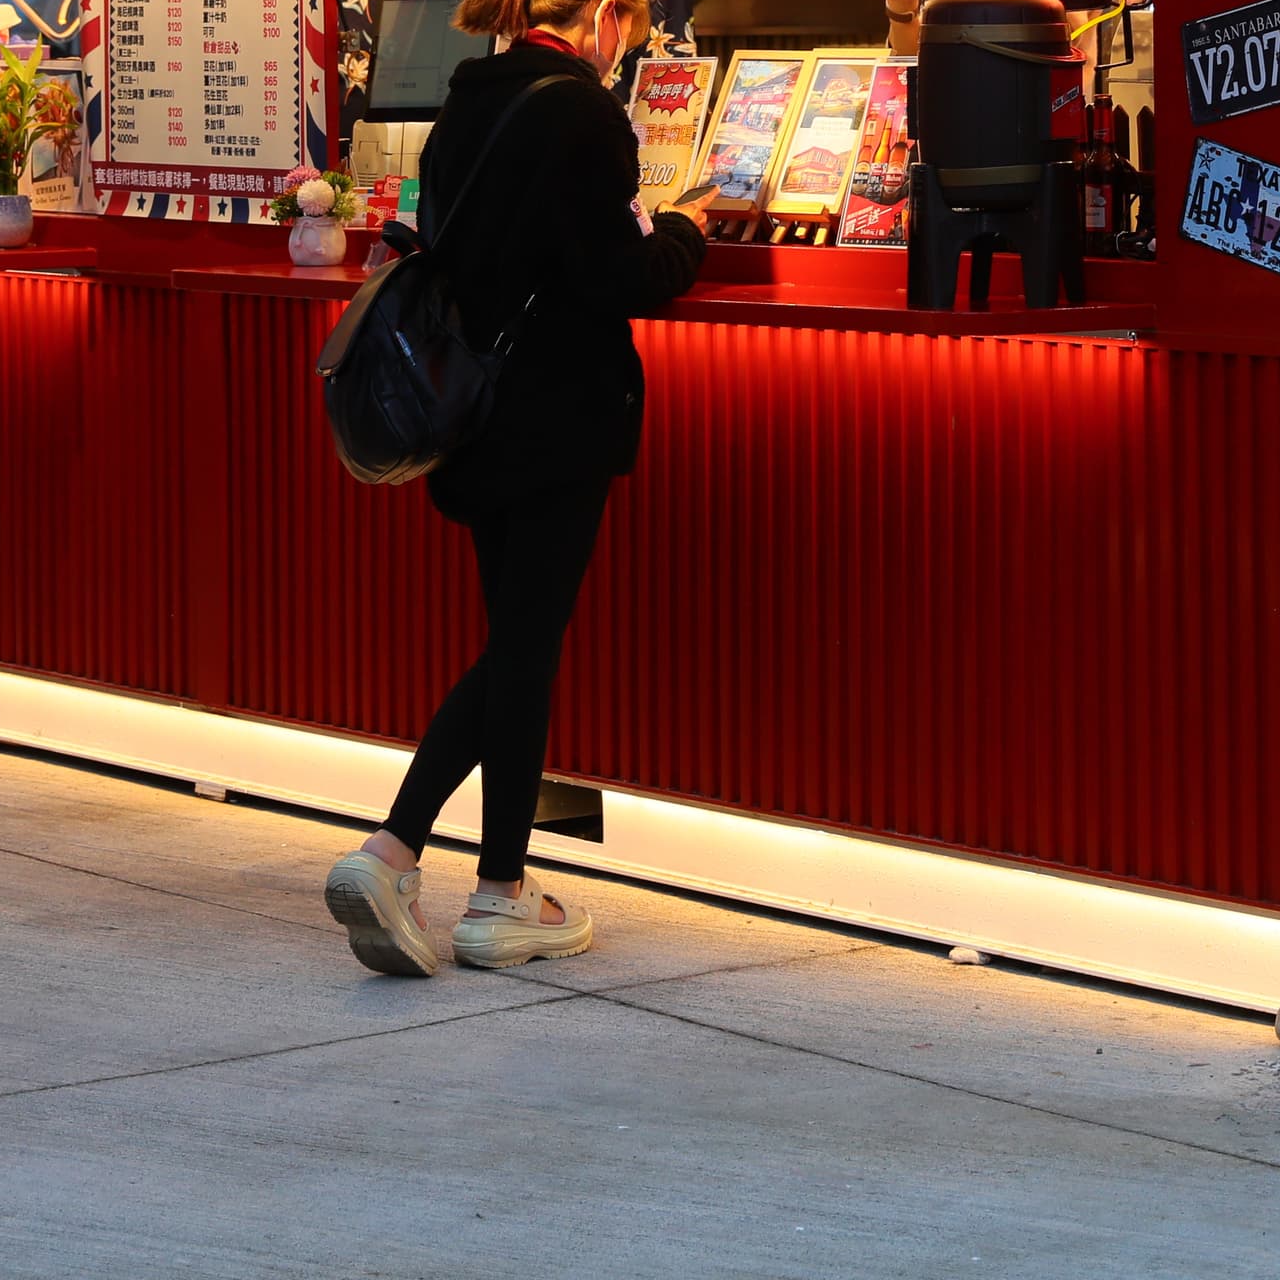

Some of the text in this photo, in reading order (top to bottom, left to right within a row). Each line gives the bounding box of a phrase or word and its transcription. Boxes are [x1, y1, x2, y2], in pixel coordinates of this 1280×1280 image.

[167, 7, 182, 17] $120
[263, 13, 277, 23] $80
[167, 22, 182, 32] $120
[203, 27, 280, 38] 可可 $100
[167, 36, 182, 46] $150
[167, 62, 183, 72] $160
[264, 61, 278, 71] $65
[264, 76, 278, 86] $65
[264, 90, 277, 101] $70
[117, 105, 183, 117] 360ml $120
[264, 105, 277, 116] $75
[117, 119, 183, 132] 500ml $140
[264, 120, 276, 131] $10
[117, 134, 187, 147] 4000ml $1000
[638, 161, 676, 186] $100
[1189, 175, 1242, 233] ABC
